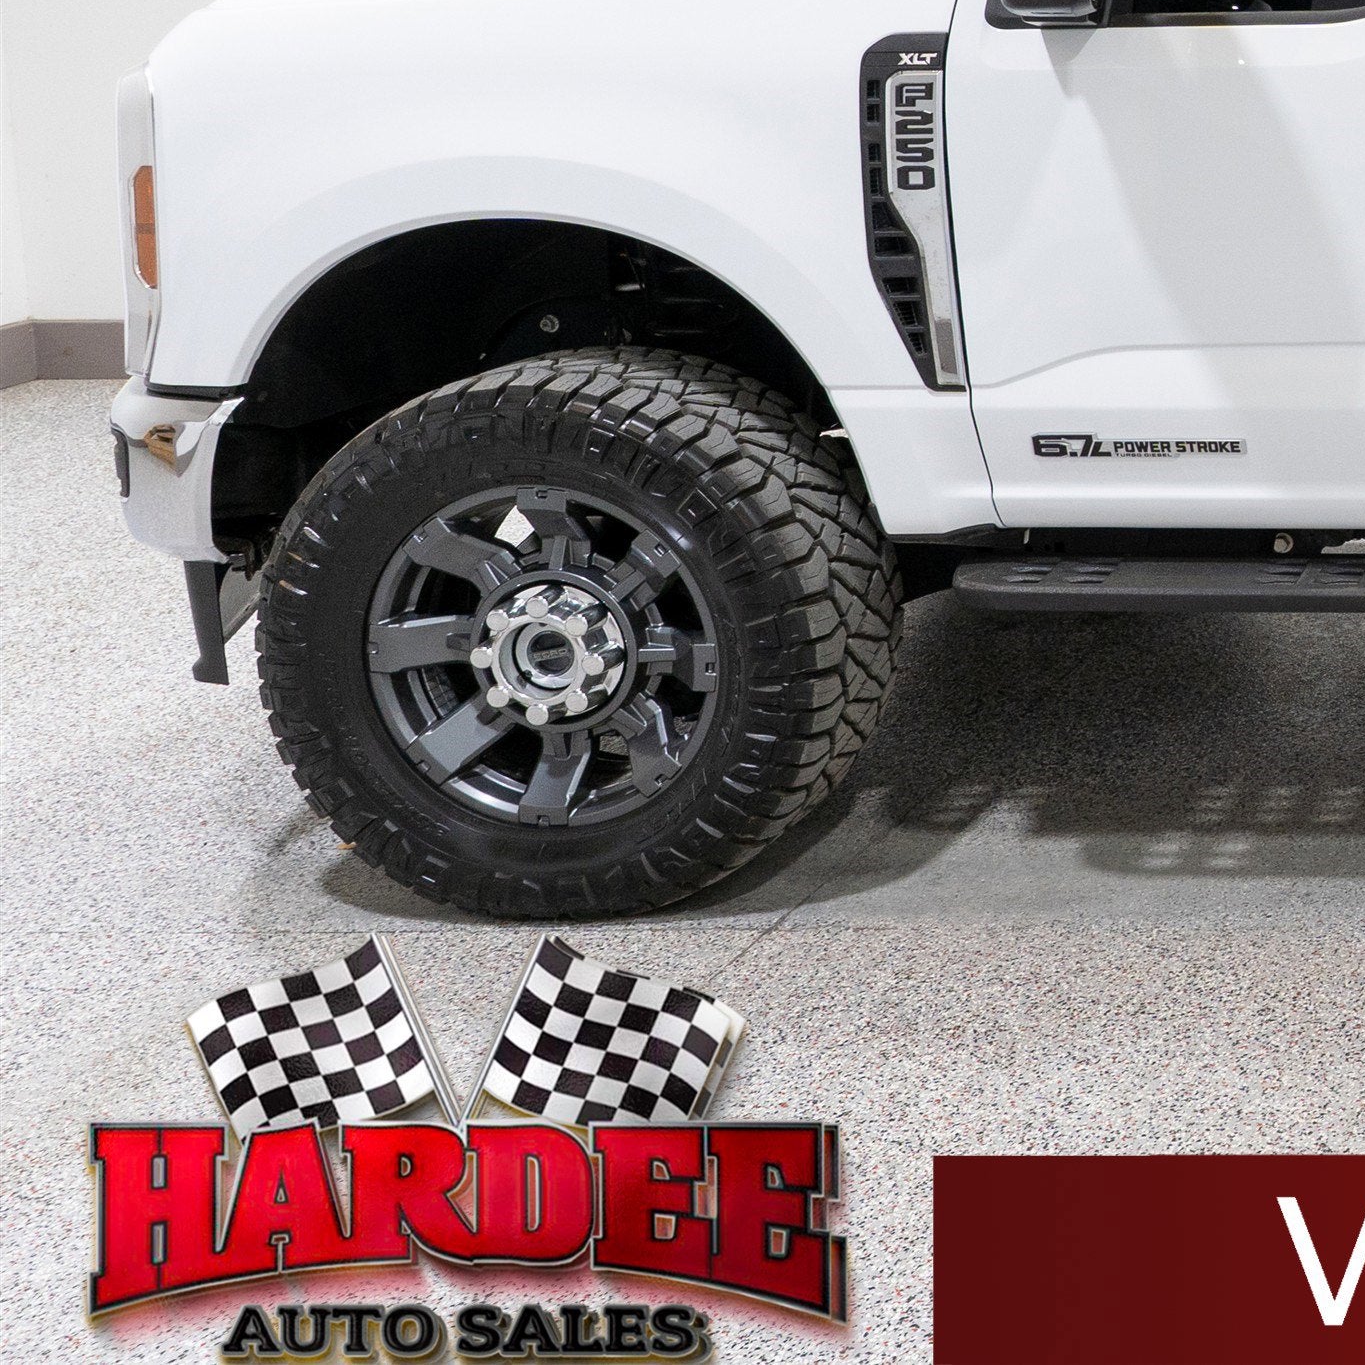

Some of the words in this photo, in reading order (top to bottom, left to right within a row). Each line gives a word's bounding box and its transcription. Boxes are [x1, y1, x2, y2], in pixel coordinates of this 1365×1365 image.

[898, 53, 937, 65] XLT
[895, 82, 935, 190] F250
[1113, 441, 1172, 453] POWER
[1175, 441, 1241, 453] STROKE
